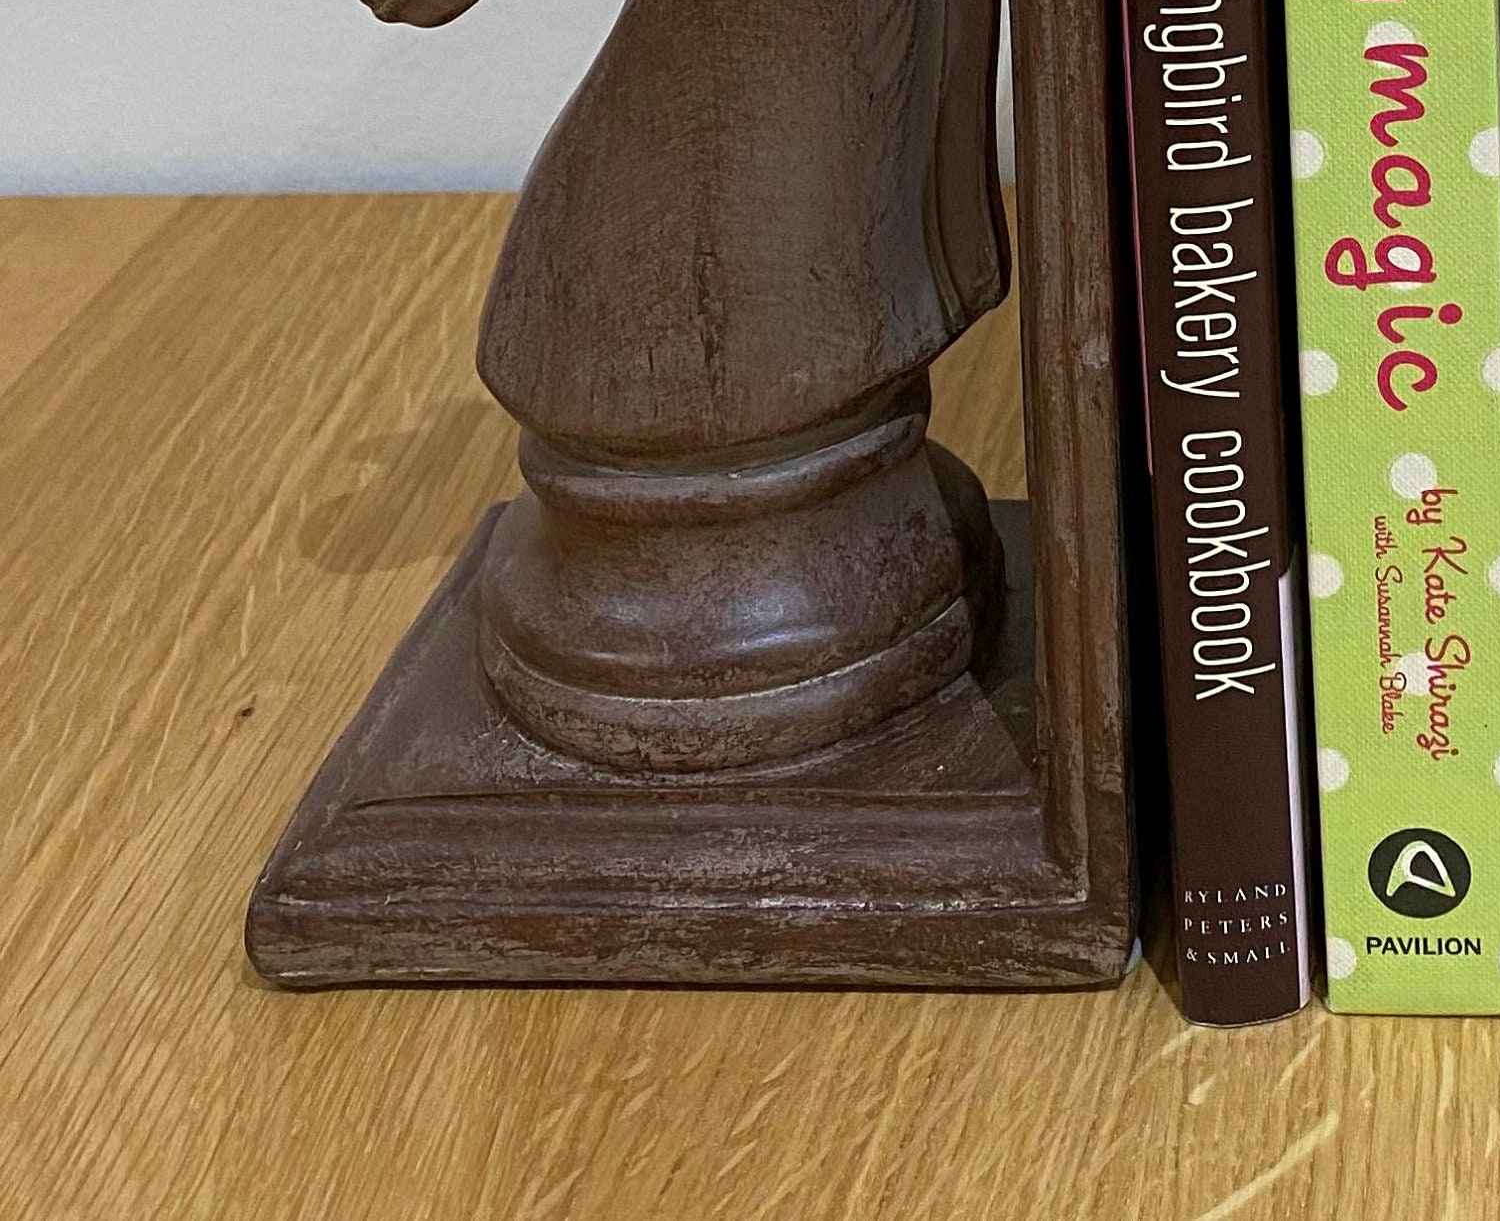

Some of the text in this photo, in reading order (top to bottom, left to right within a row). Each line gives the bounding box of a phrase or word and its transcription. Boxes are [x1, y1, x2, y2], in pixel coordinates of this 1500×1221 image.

[1160, 198, 1255, 399] bakery
[1325, 42, 1461, 411] magic
[1182, 431, 1276, 700] cookbook
[1374, 515, 1407, 734] with Susannah Blake
[1406, 488, 1471, 761] by Kate Shirazi
[1184, 884, 1287, 904] RYLAND
[1184, 911, 1289, 935] PETERS
[1186, 941, 1291, 965] & SMALL
[1365, 934, 1483, 958] PAVILION
